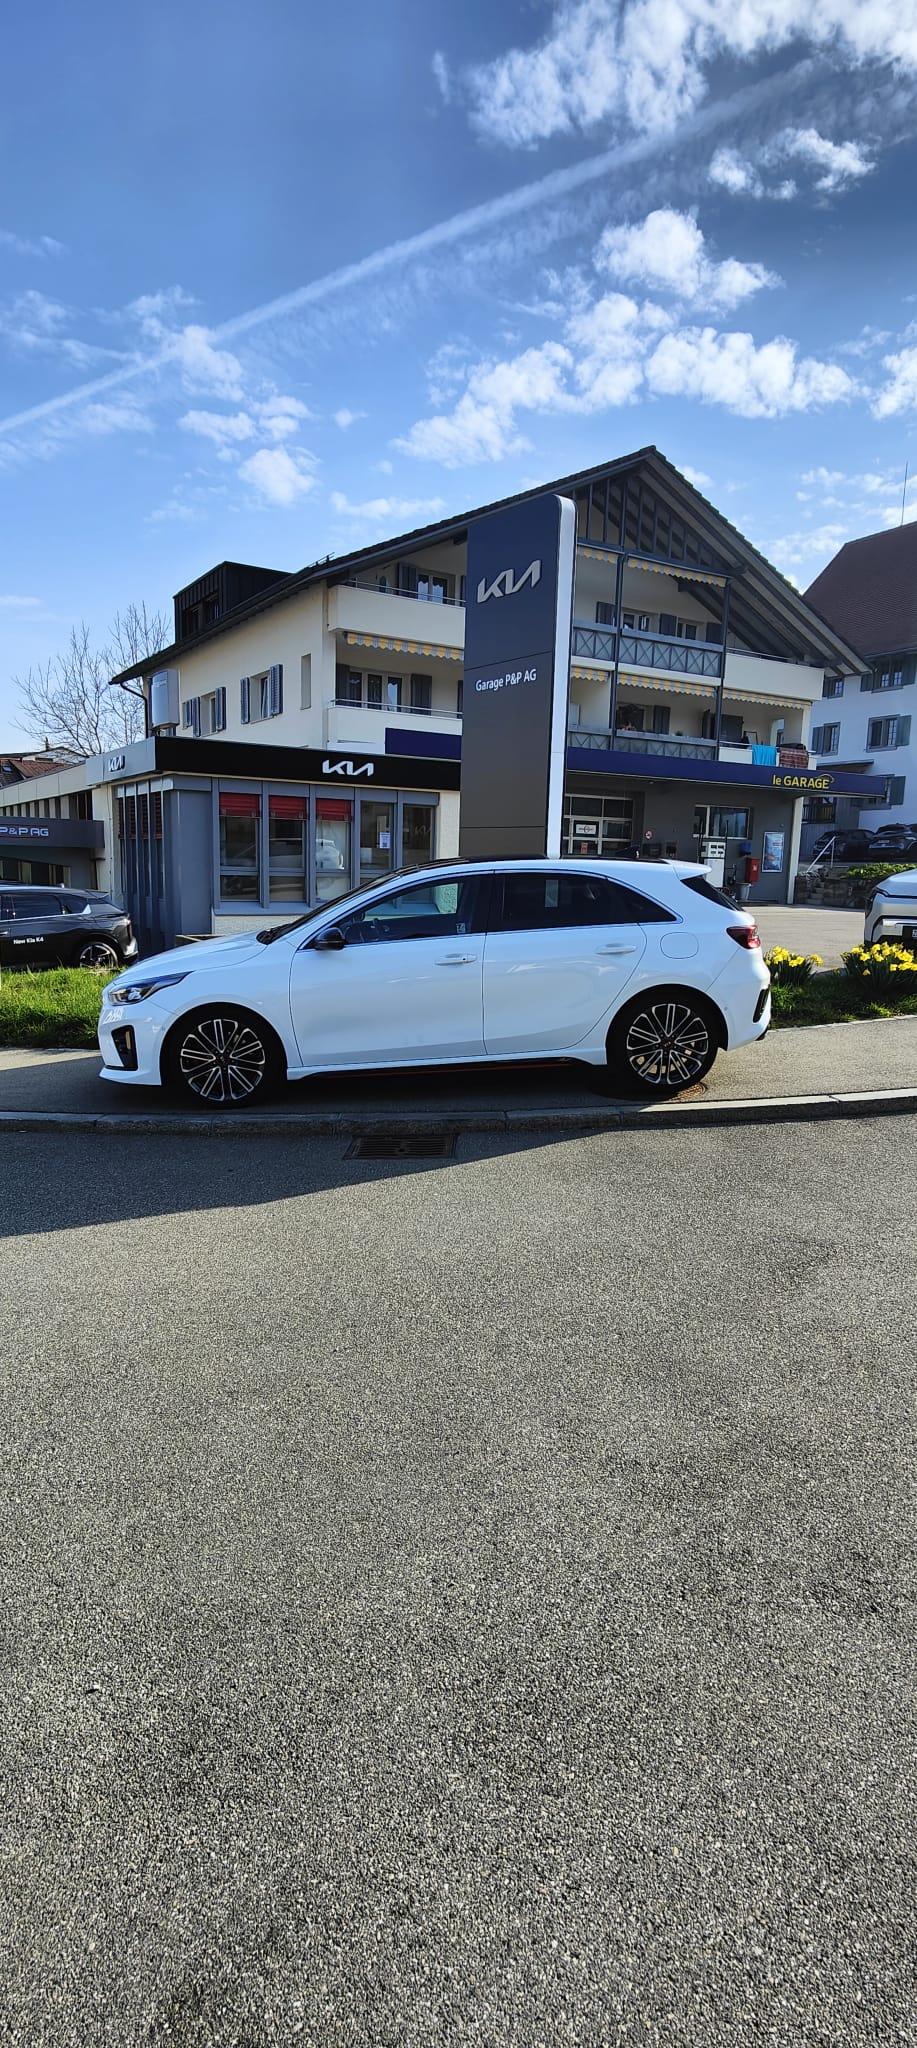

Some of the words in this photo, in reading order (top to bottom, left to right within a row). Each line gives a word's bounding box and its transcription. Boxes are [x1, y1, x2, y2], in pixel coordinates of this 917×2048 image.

[477, 559, 541, 603] KIA
[475, 678, 504, 692] Garage
[505, 671, 522, 686] P&P
[523, 668, 537, 683] AG
[322, 759, 374, 777] KIA
[772, 774, 782, 786] le
[783, 775, 830, 790] GARAGE
[30, 827, 49, 837] AG
